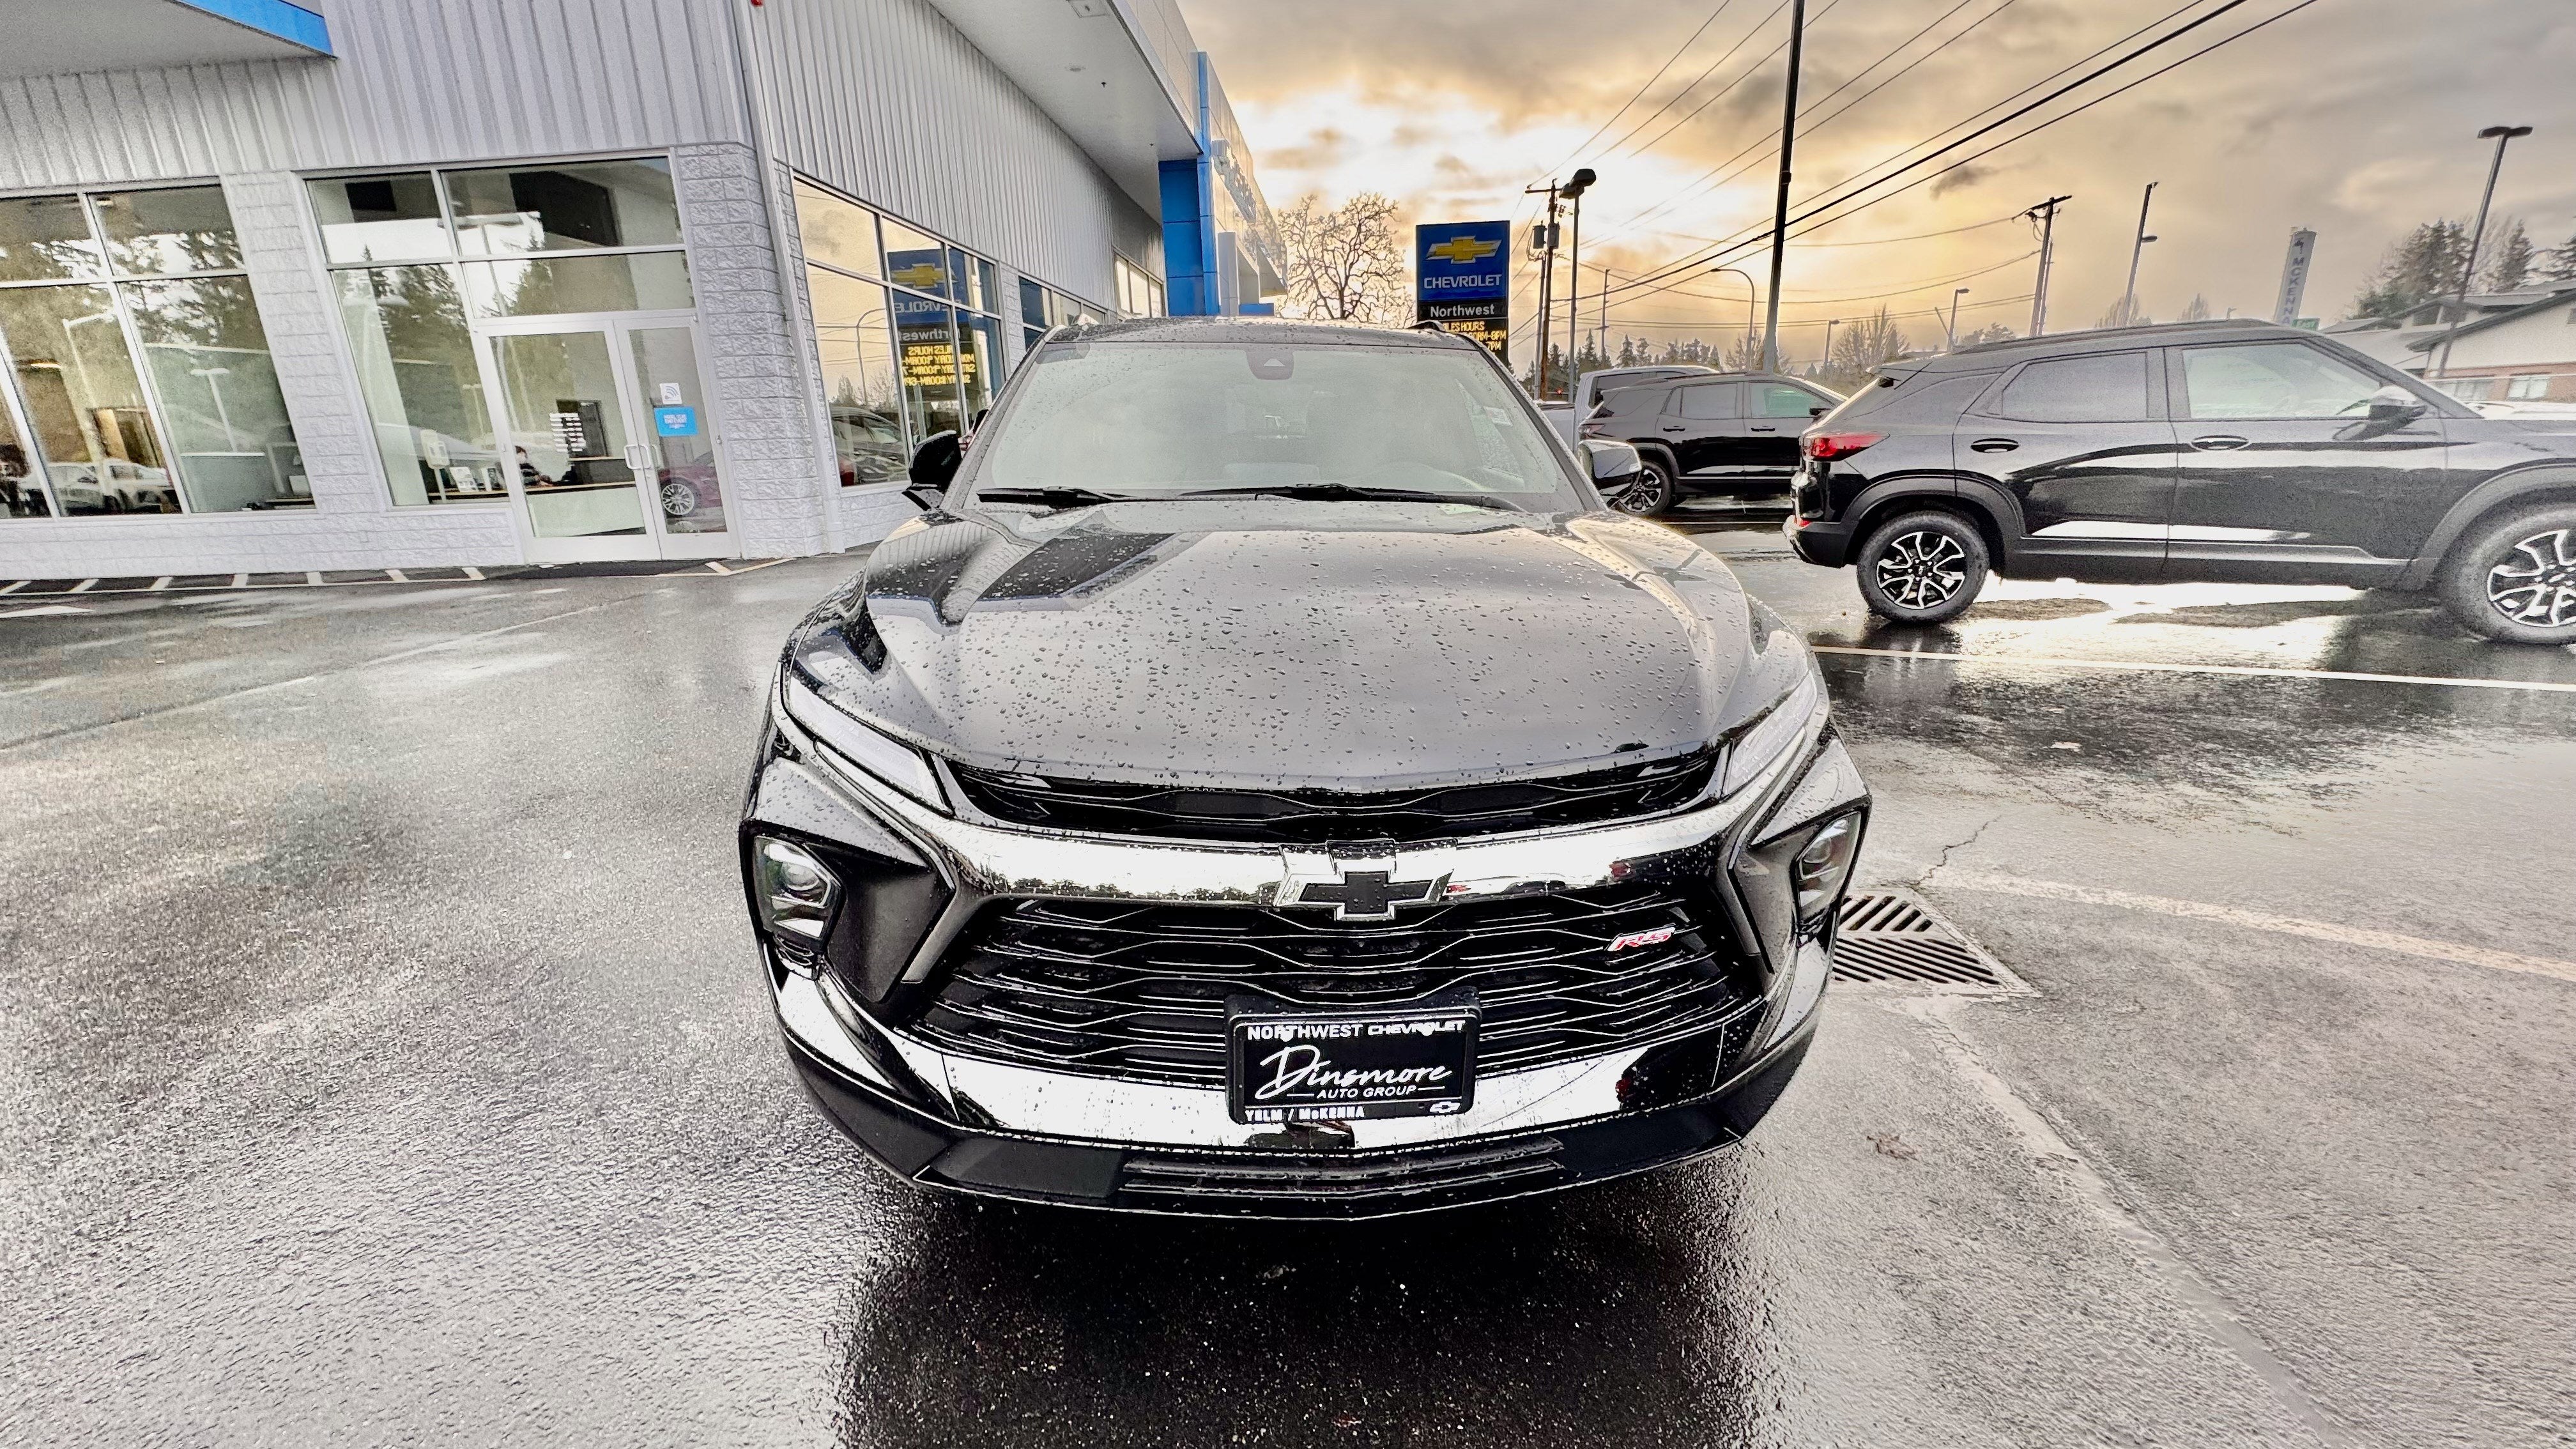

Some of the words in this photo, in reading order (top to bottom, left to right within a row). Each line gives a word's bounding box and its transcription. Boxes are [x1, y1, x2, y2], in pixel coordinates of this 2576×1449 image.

[1423, 274, 1502, 289] CHEVROLET
[1430, 304, 1495, 318] Northwest
[1460, 321, 1485, 331] HOURS
[1607, 926, 1676, 951] RS
[1246, 1024, 1363, 1041] NORTHWEST
[1367, 1020, 1466, 1036] CHEVROLET
[1254, 1045, 1453, 1100] Dinsmore
[1316, 1087, 1358, 1100] AUTO
[1363, 1085, 1418, 1098] GROUP
[1245, 1109, 1283, 1122] YELM
[1298, 1106, 1365, 1121] McKENNA
